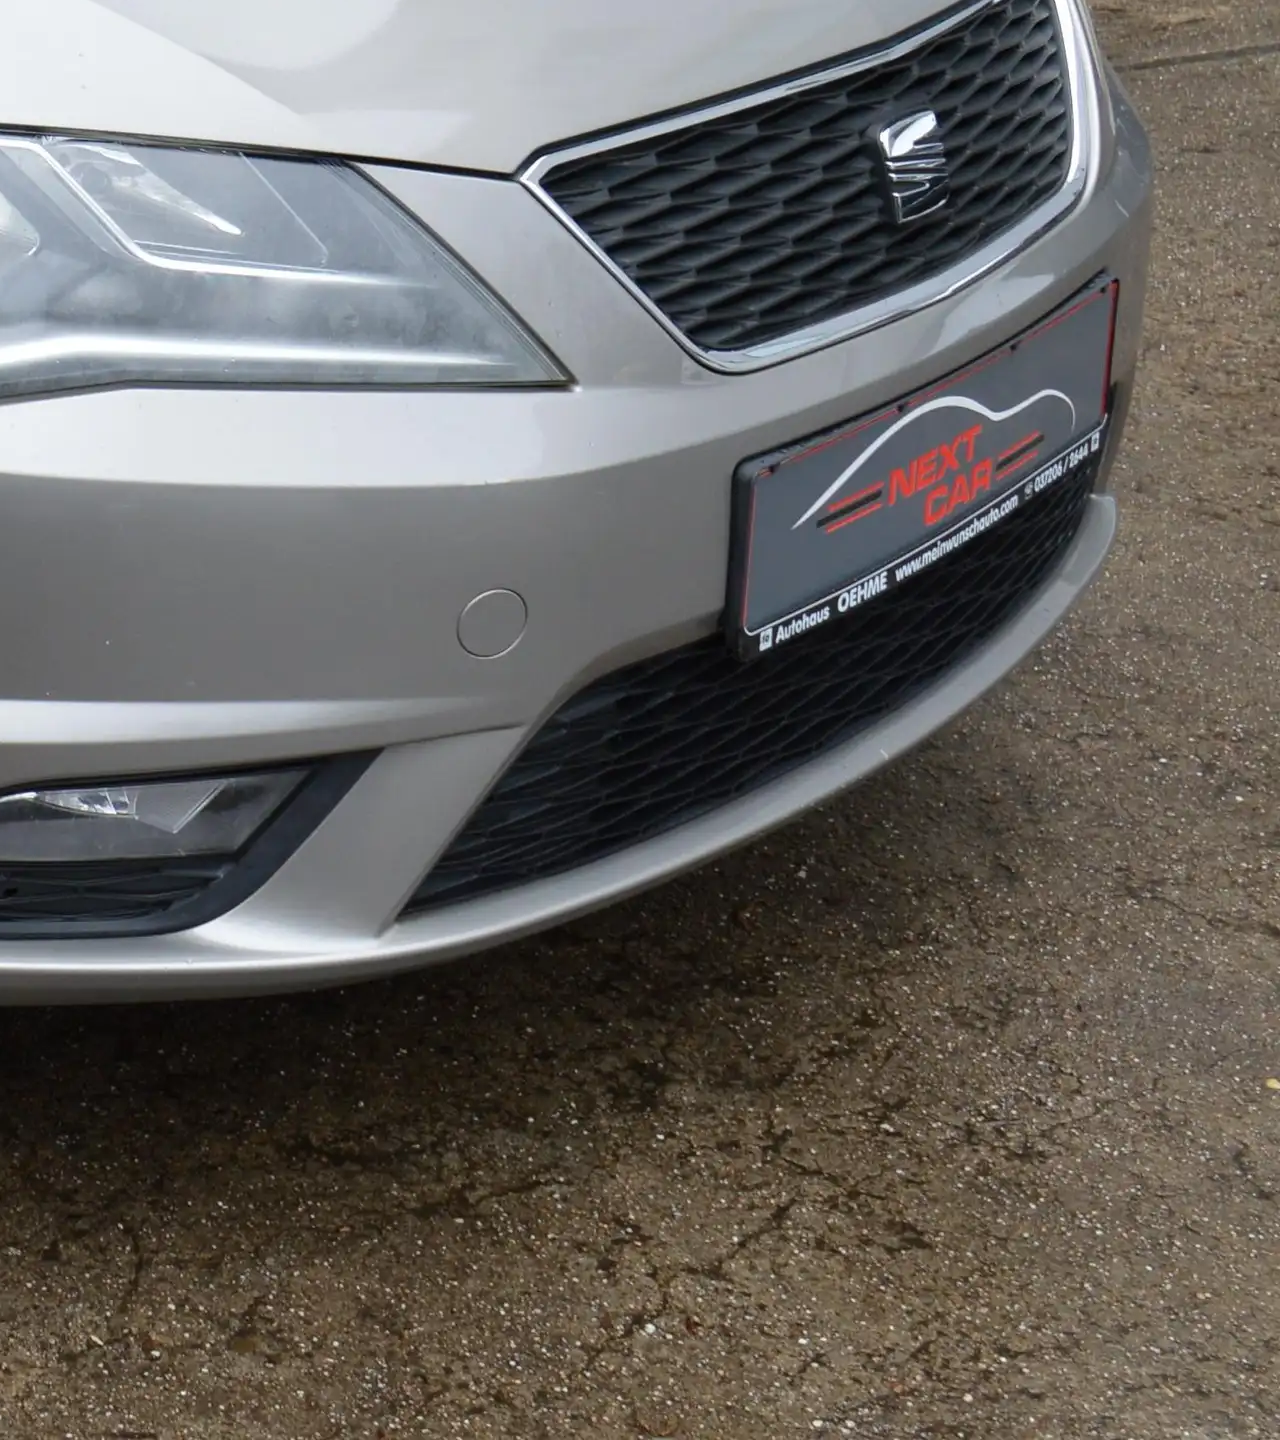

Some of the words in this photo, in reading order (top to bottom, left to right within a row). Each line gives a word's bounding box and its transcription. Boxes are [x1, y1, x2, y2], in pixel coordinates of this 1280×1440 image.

[888, 424, 982, 506] NEXT
[924, 457, 992, 526] CAR
[776, 606, 830, 644] Autohaus
[837, 571, 888, 612] OEHME
[895, 495, 1019, 582] www.meinwunschauto.com
[1034, 460, 1063, 492] 037206
[1069, 443, 1089, 468] 2644
